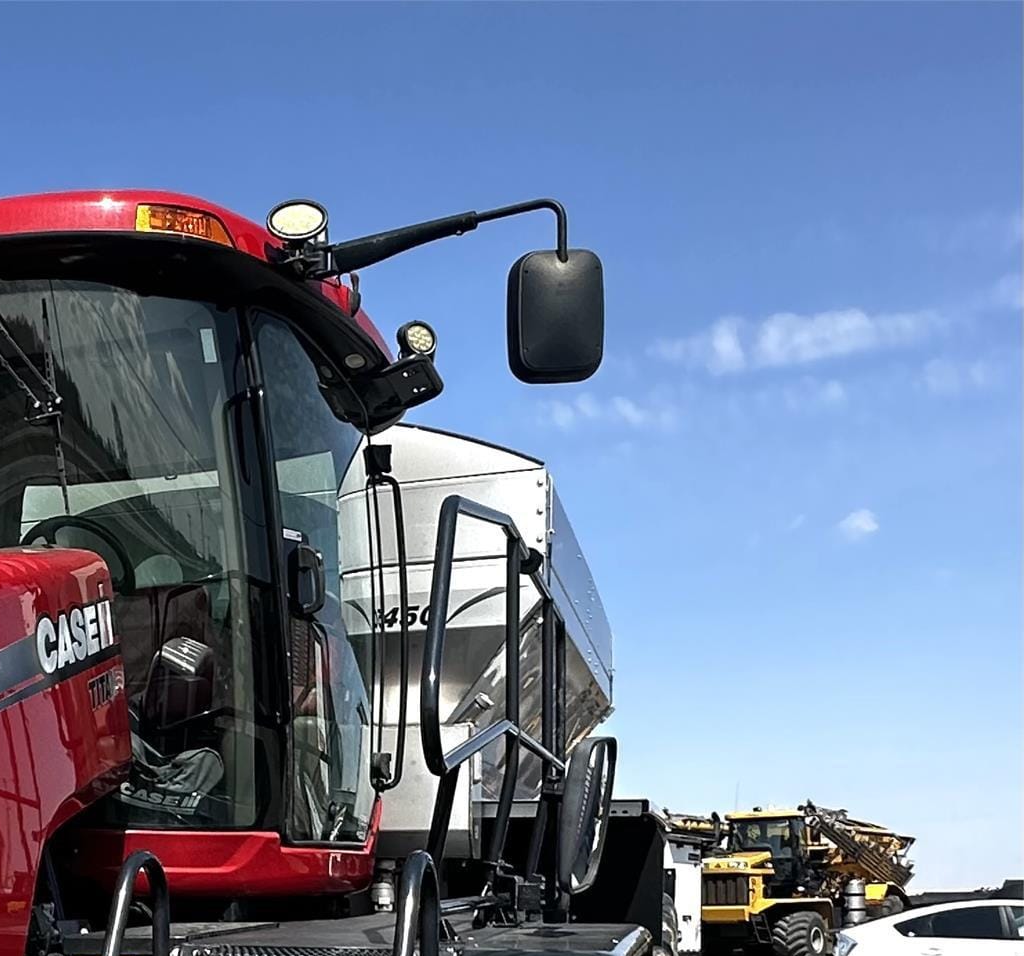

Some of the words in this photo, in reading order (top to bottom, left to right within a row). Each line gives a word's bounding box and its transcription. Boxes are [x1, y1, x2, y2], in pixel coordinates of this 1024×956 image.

[37, 604, 101, 675] CASE
[87, 669, 121, 711] TITA
[120, 782, 180, 806] CASE
